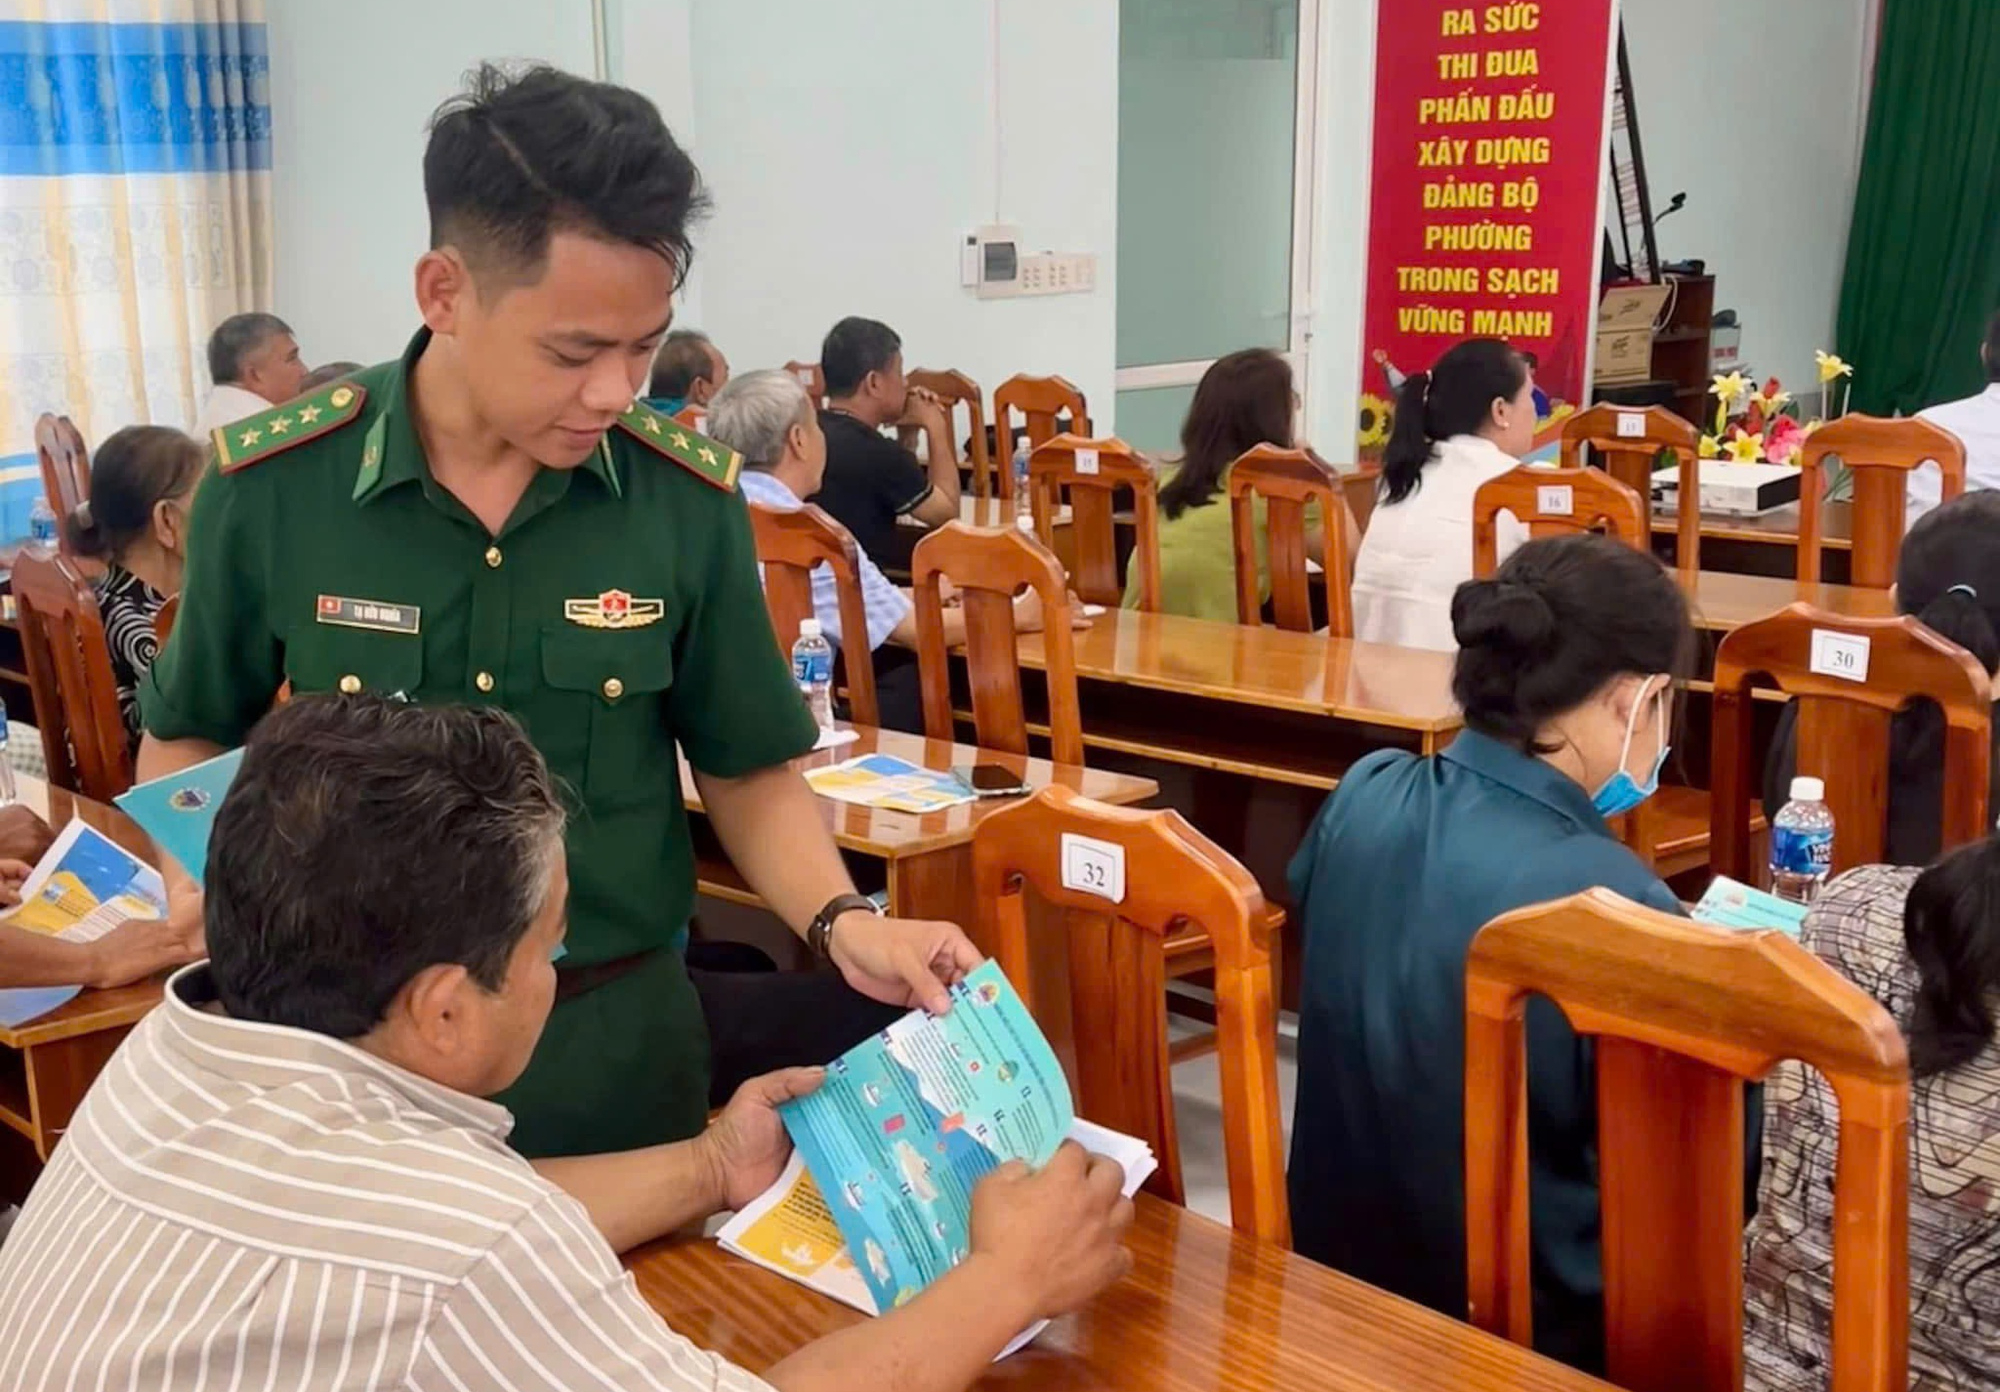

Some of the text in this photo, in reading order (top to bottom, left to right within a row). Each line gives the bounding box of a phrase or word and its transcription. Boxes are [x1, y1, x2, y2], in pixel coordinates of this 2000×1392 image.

[1442, 0, 1539, 36] RA SỨC
[1438, 49, 1538, 79] THI ĐUA
[1420, 85, 1554, 123] PHẤN ĐẤU
[1419, 136, 1549, 169] XÂY DỰNG
[1424, 175, 1538, 212] ĐẢNG BỘ
[1426, 220, 1531, 250] PHƯỜNG
[1398, 268, 1558, 298] TRONG SẠCH
[1399, 305, 1552, 340] VỮNG MẠNH
[1832, 650, 1854, 670] 30
[1083, 862, 1105, 888] 32
